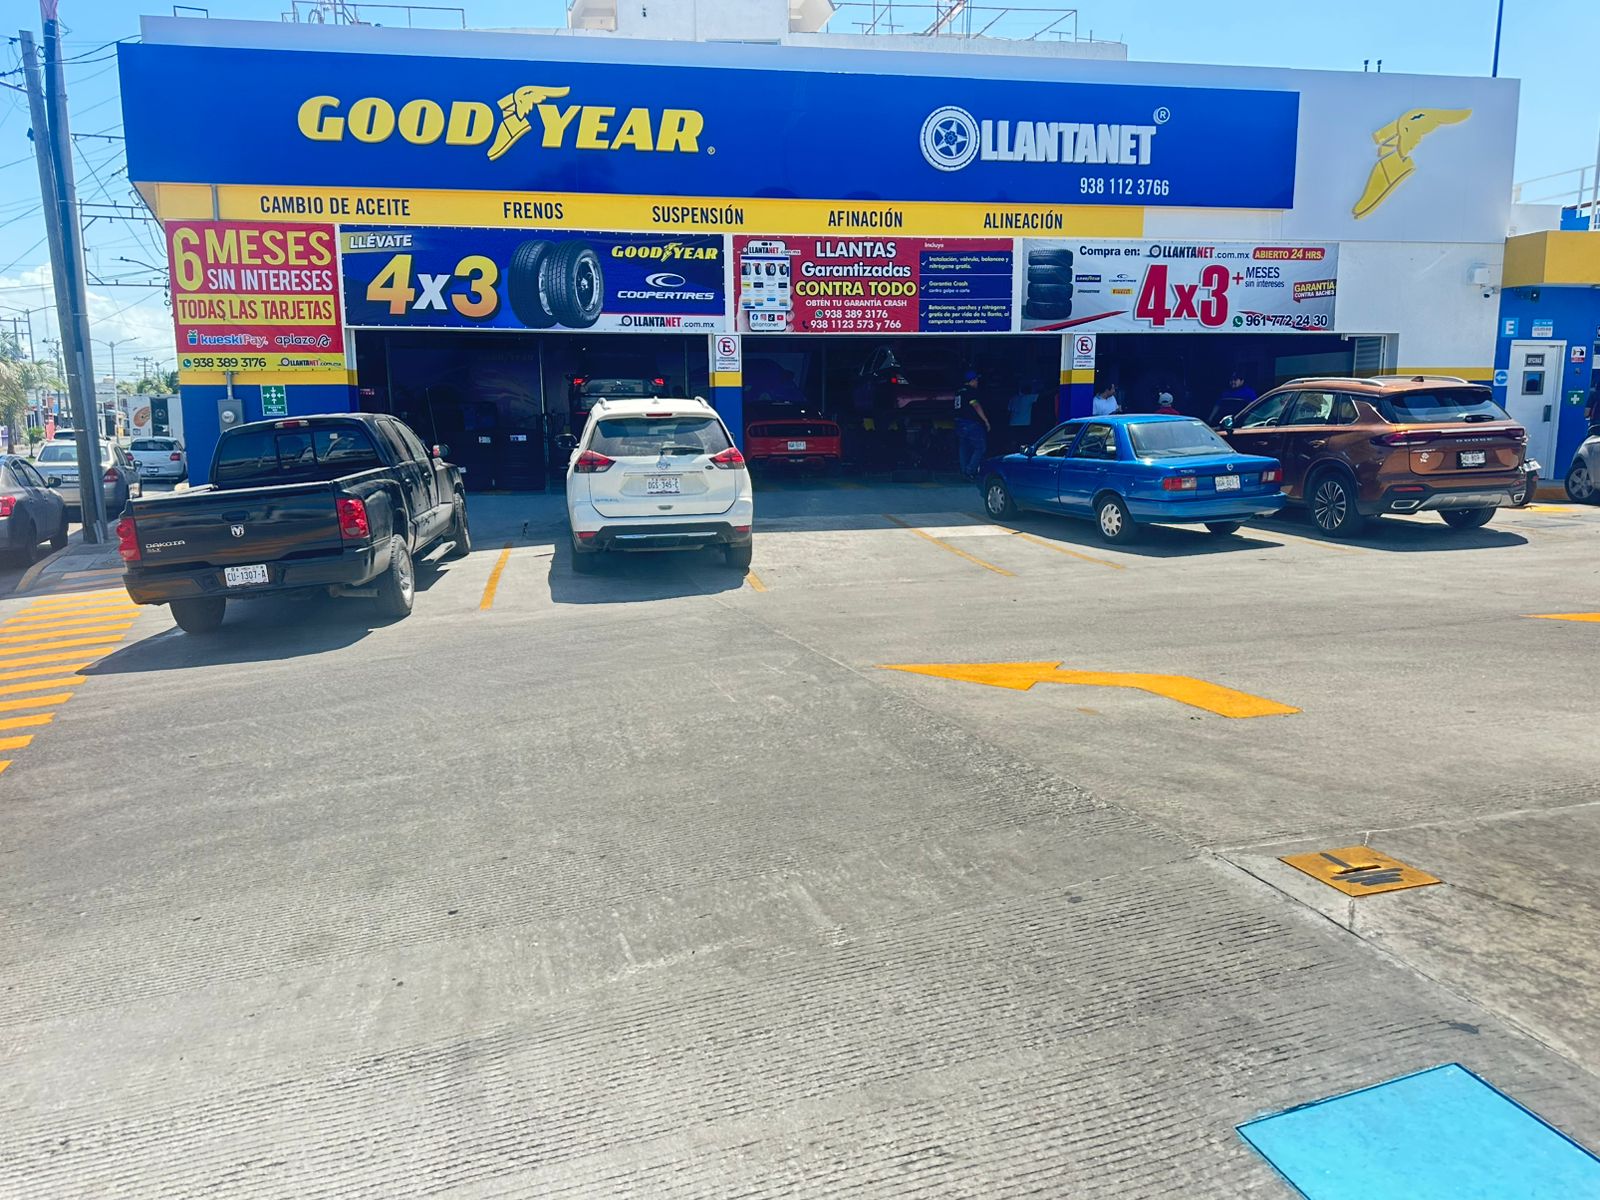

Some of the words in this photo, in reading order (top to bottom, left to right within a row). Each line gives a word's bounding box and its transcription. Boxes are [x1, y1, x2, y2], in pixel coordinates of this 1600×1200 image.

[1080, 177, 1104, 194] 938
[1110, 178, 1133, 195] 112
[1137, 179, 1169, 196] 3766
[260, 195, 324, 214] CAMBIO
[329, 197, 350, 215] DE
[355, 198, 411, 216] ACEITE
[503, 201, 564, 220] FRENOS
[652, 204, 744, 225] SUSPENSIÓN
[828, 207, 903, 228] AFINACIÓN
[983, 210, 1063, 229] ALINEACIÓN
[350, 233, 413, 249] LLÉVATE
[816, 241, 897, 258] LLANTAS
[1079, 245, 1121, 258] Compra
[1124, 247, 1141, 256] en:
[1255, 250, 1289, 259] ABIERTO
[1290, 248, 1304, 259] 24
[1305, 251, 1323, 259] HRS.
[172, 227, 204, 292] 6
[204, 228, 332, 267] MESES
[801, 261, 912, 277] Garantizadas
[1245, 266, 1280, 279] MESES
[207, 268, 235, 291] SIN
[241, 269, 333, 292] INTERESES
[1245, 280, 1255, 288] sin
[1256, 279, 1285, 288] intereses
[1294, 281, 1335, 292] GARANTÍA
[617, 290, 715, 300] COOPERTIRES
[795, 281, 865, 297] CONTRA
[869, 281, 917, 297] TODO
[179, 299, 226, 320] TODAS
[229, 300, 258, 320] LAS
[261, 300, 333, 320] TARJETAS
[805, 297, 831, 307] OBTÉN
[832, 299, 842, 307] TU
[844, 297, 882, 307] GARANTÍA
[883, 299, 908, 307] CRASH
[825, 309, 843, 319] 938
[845, 309, 863, 319] 389
[865, 309, 889, 319] 3176
[1246, 315, 1266, 327] 961
[1271, 315, 1292, 327] 772
[1295, 315, 1310, 327] 24
[1313, 315, 1328, 327] 30
[810, 320, 829, 329] 938
[831, 320, 855, 329] 1123
[856, 320, 874, 329] 573
[876, 322, 882, 331] y
[884, 320, 902, 329] 766
[1505, 320, 1515, 335] E
[275, 333, 317, 347] aplazo
[193, 357, 214, 368] 938
[216, 357, 238, 368] 389
[240, 357, 267, 368] 3176
[226, 568, 267, 582] CU-1307-A
